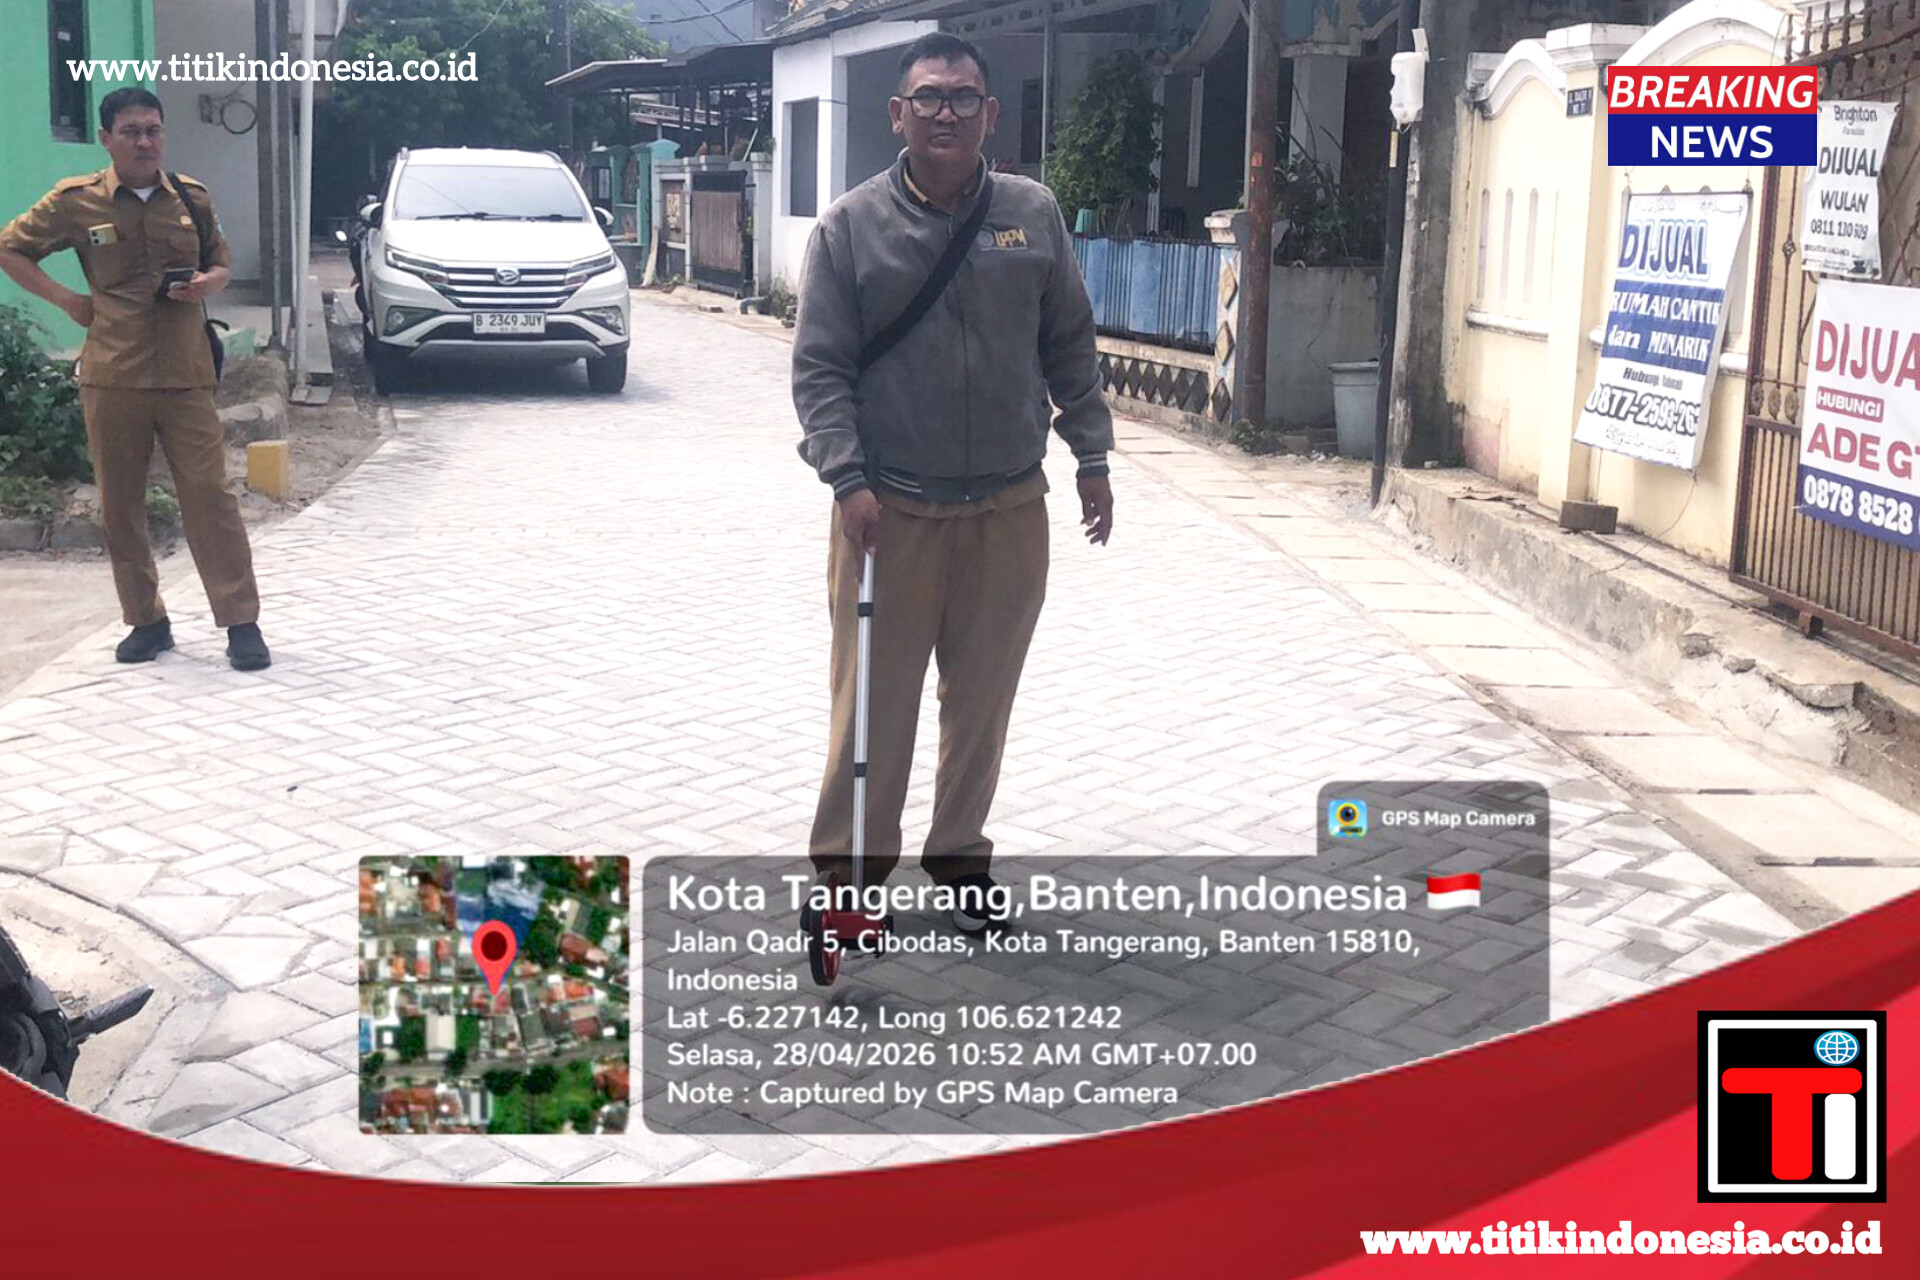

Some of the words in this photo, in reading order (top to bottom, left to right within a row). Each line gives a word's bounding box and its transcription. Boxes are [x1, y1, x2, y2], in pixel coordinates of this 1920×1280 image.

[1833, 105, 1878, 126] Brighton
[1818, 146, 1880, 177] DIJUAL
[1821, 189, 1870, 213] WULAN
[1616, 220, 1710, 279] DIJUAL
[475, 314, 483, 326] B
[1647, 331, 1711, 363] MENARIK
[1816, 390, 1882, 418] HUBUNGI
[1806, 422, 1881, 472] ADE
[1803, 474, 1855, 518] 0878
[1857, 490, 1915, 536] 8528
